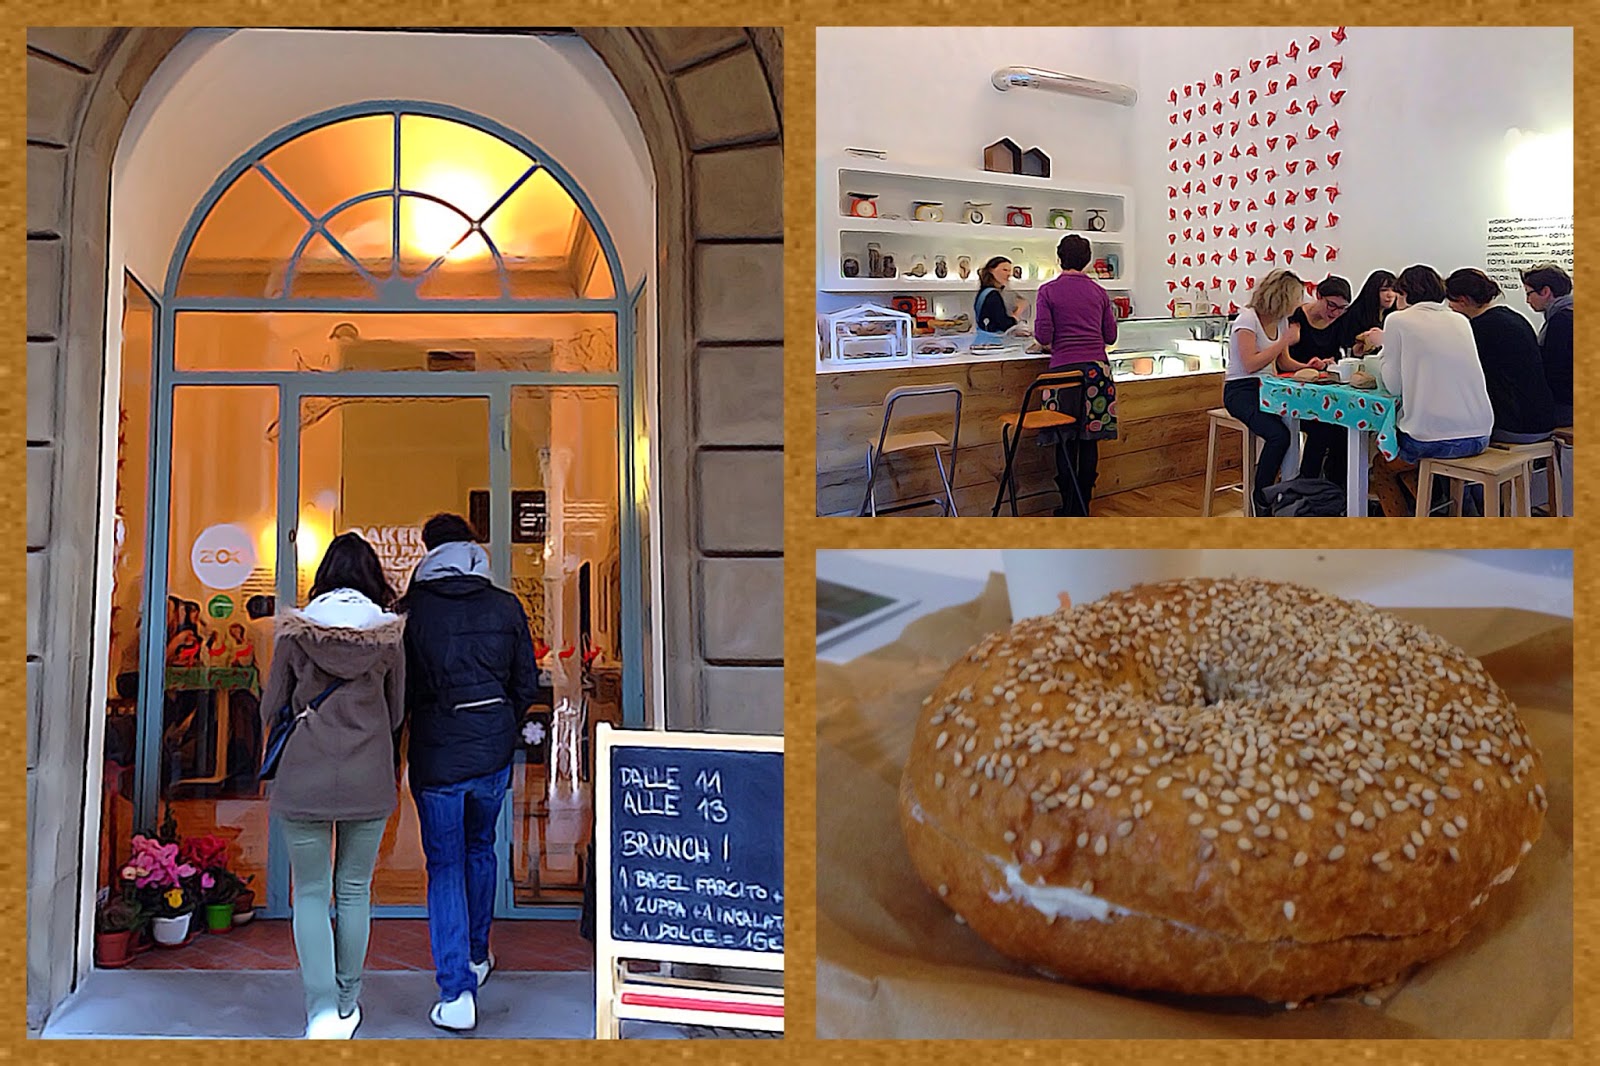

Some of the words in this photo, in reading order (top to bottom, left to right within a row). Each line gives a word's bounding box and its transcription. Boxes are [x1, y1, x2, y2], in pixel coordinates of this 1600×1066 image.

[619, 766, 681, 791] DALLE
[694, 769, 722, 794] 11
[623, 790, 681, 816] ALLE
[696, 796, 729, 823] 13
[620, 830, 711, 864] BRUNCH
[618, 865, 629, 890] 1
[633, 870, 691, 892] BAGEL
[695, 878, 768, 900] FARCITO
[619, 894, 629, 914] 1
[635, 895, 687, 919] ZUPPA
[654, 922, 717, 944] DOLCE
